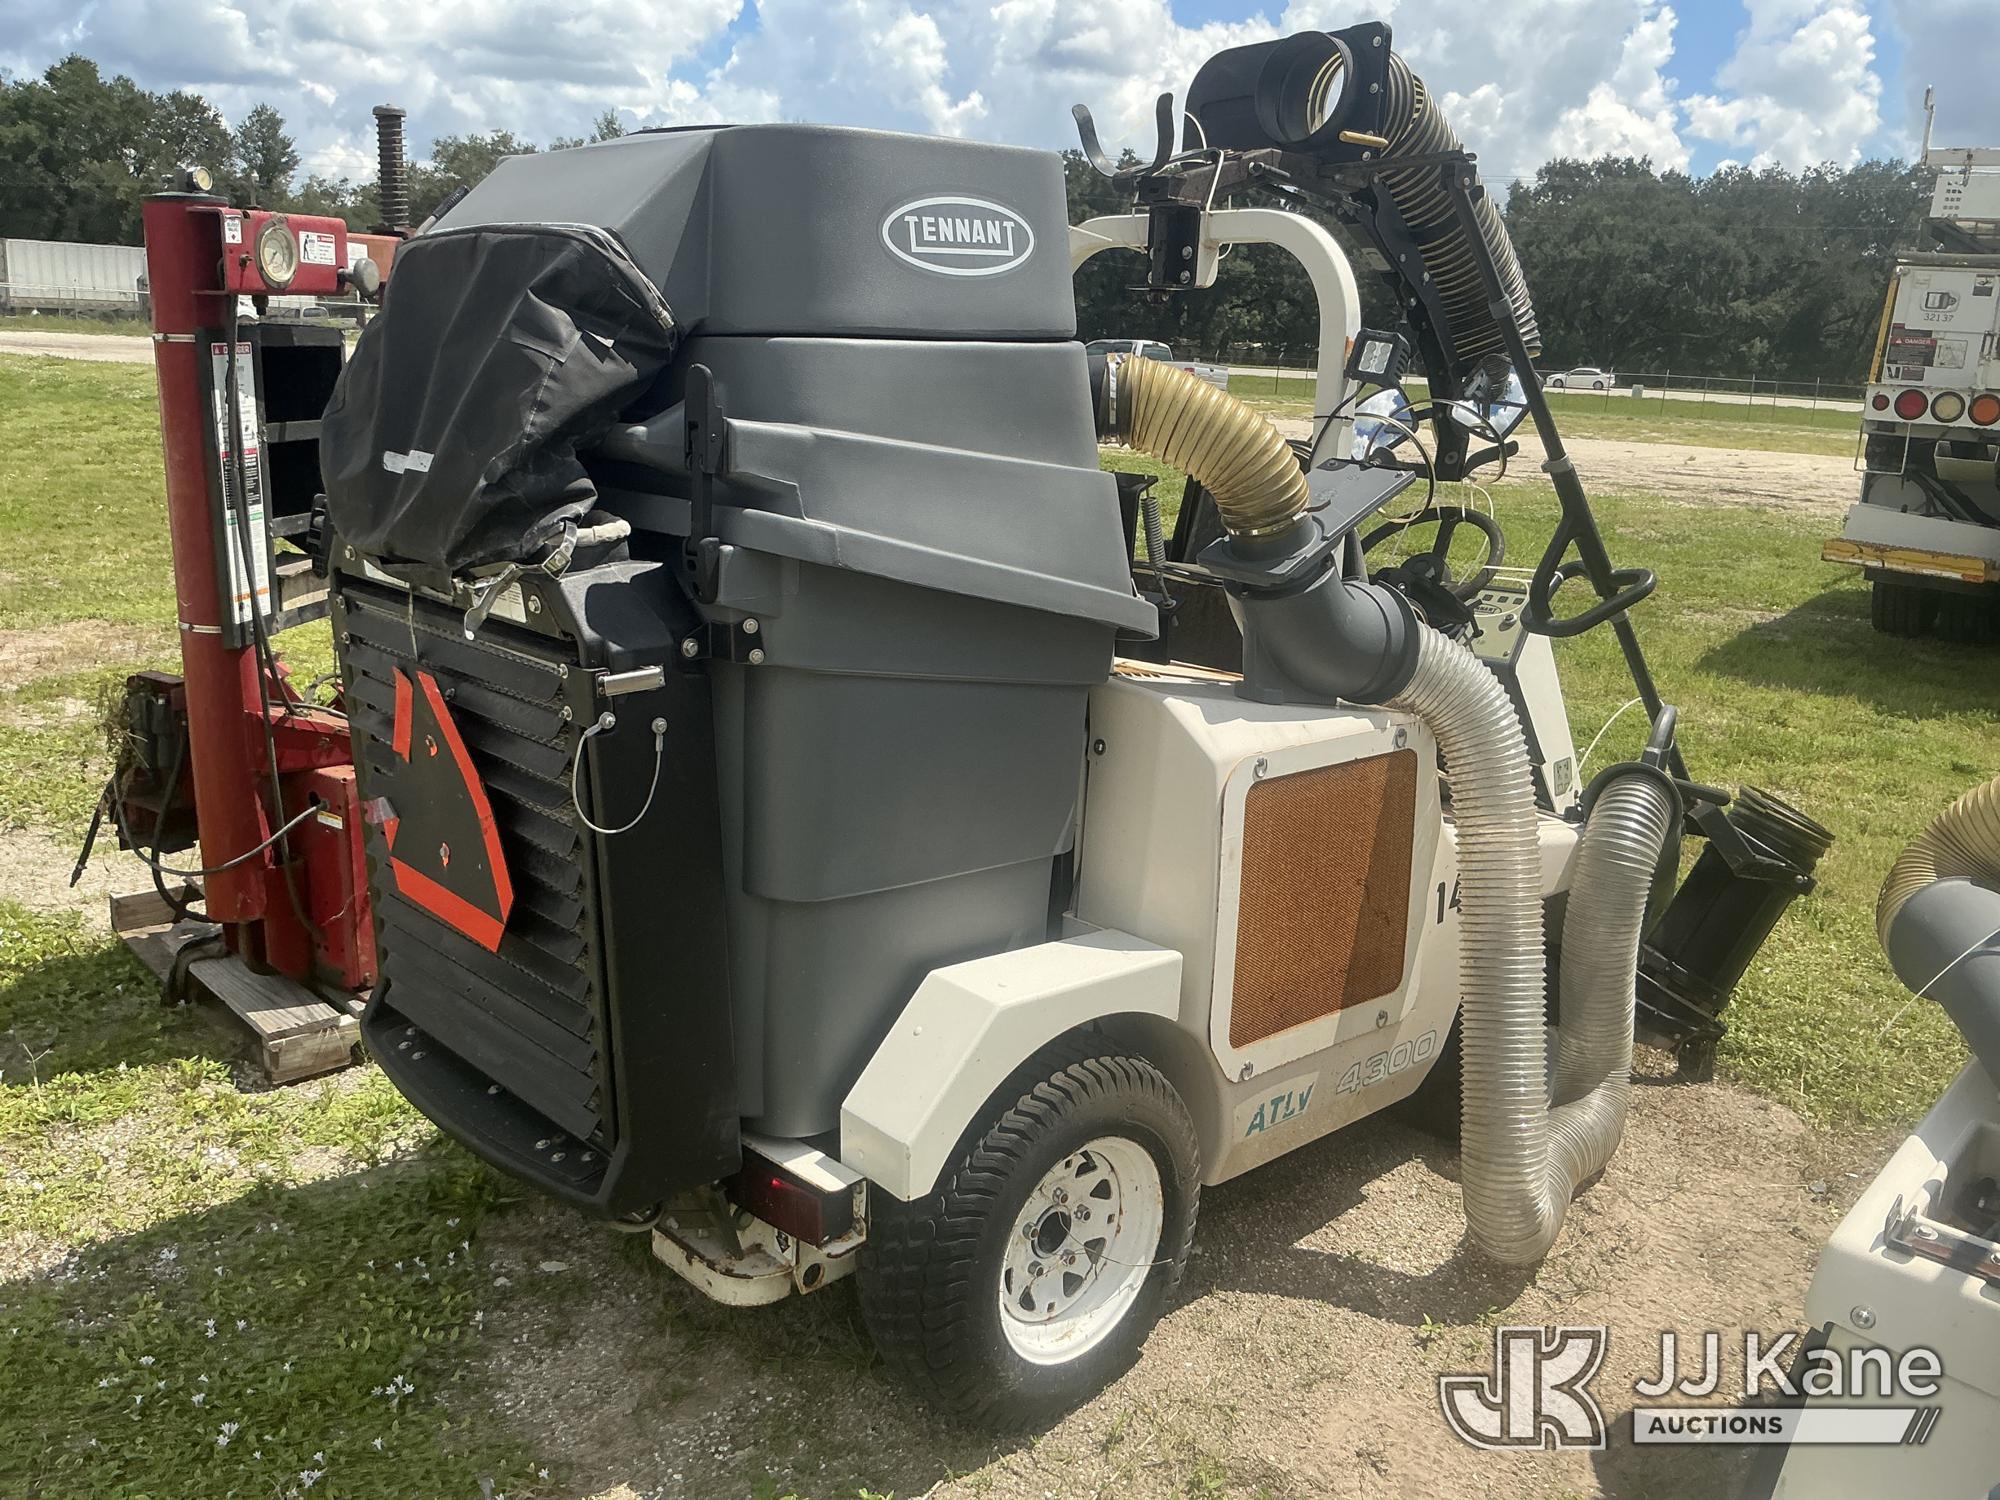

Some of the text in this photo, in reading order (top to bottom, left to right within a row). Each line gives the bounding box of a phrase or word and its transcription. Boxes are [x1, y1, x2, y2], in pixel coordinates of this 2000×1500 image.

[904, 215, 1015, 256] TENNANT
[1923, 312, 1954, 322] 32137
[222, 345, 250, 355] DGER
[1244, 1029, 1437, 1137] ATLV 4300
